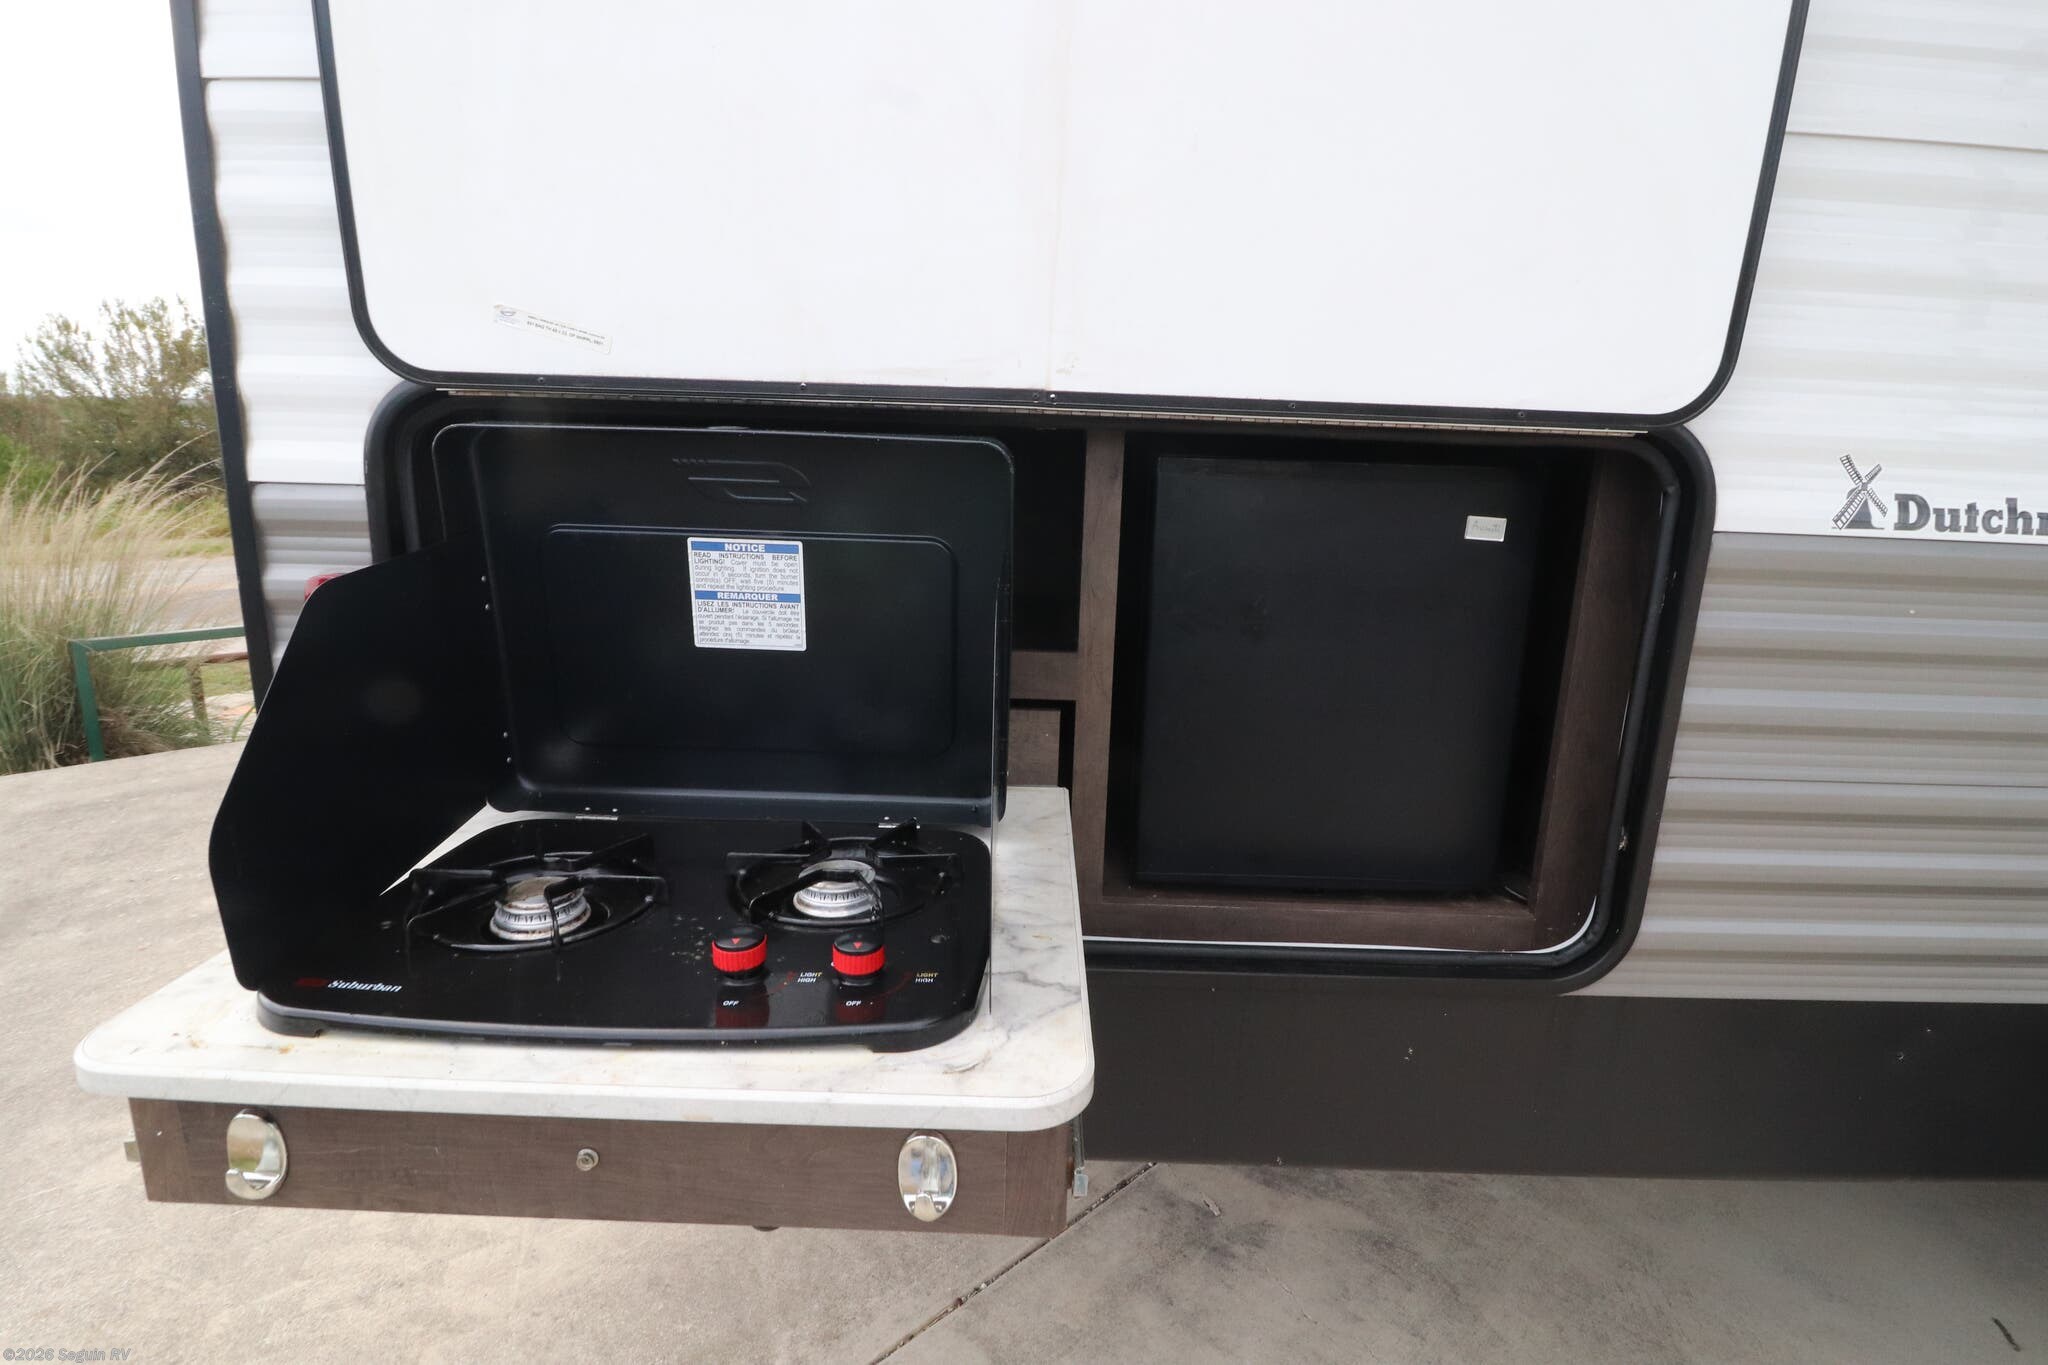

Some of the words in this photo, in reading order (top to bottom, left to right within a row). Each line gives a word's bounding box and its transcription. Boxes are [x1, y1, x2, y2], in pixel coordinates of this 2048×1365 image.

[724, 543, 766, 553] NOTICE
[719, 552, 765, 560] INSTRUCTIONS
[717, 591, 778, 601] REMARQUER
[328, 979, 402, 993] Suburban
